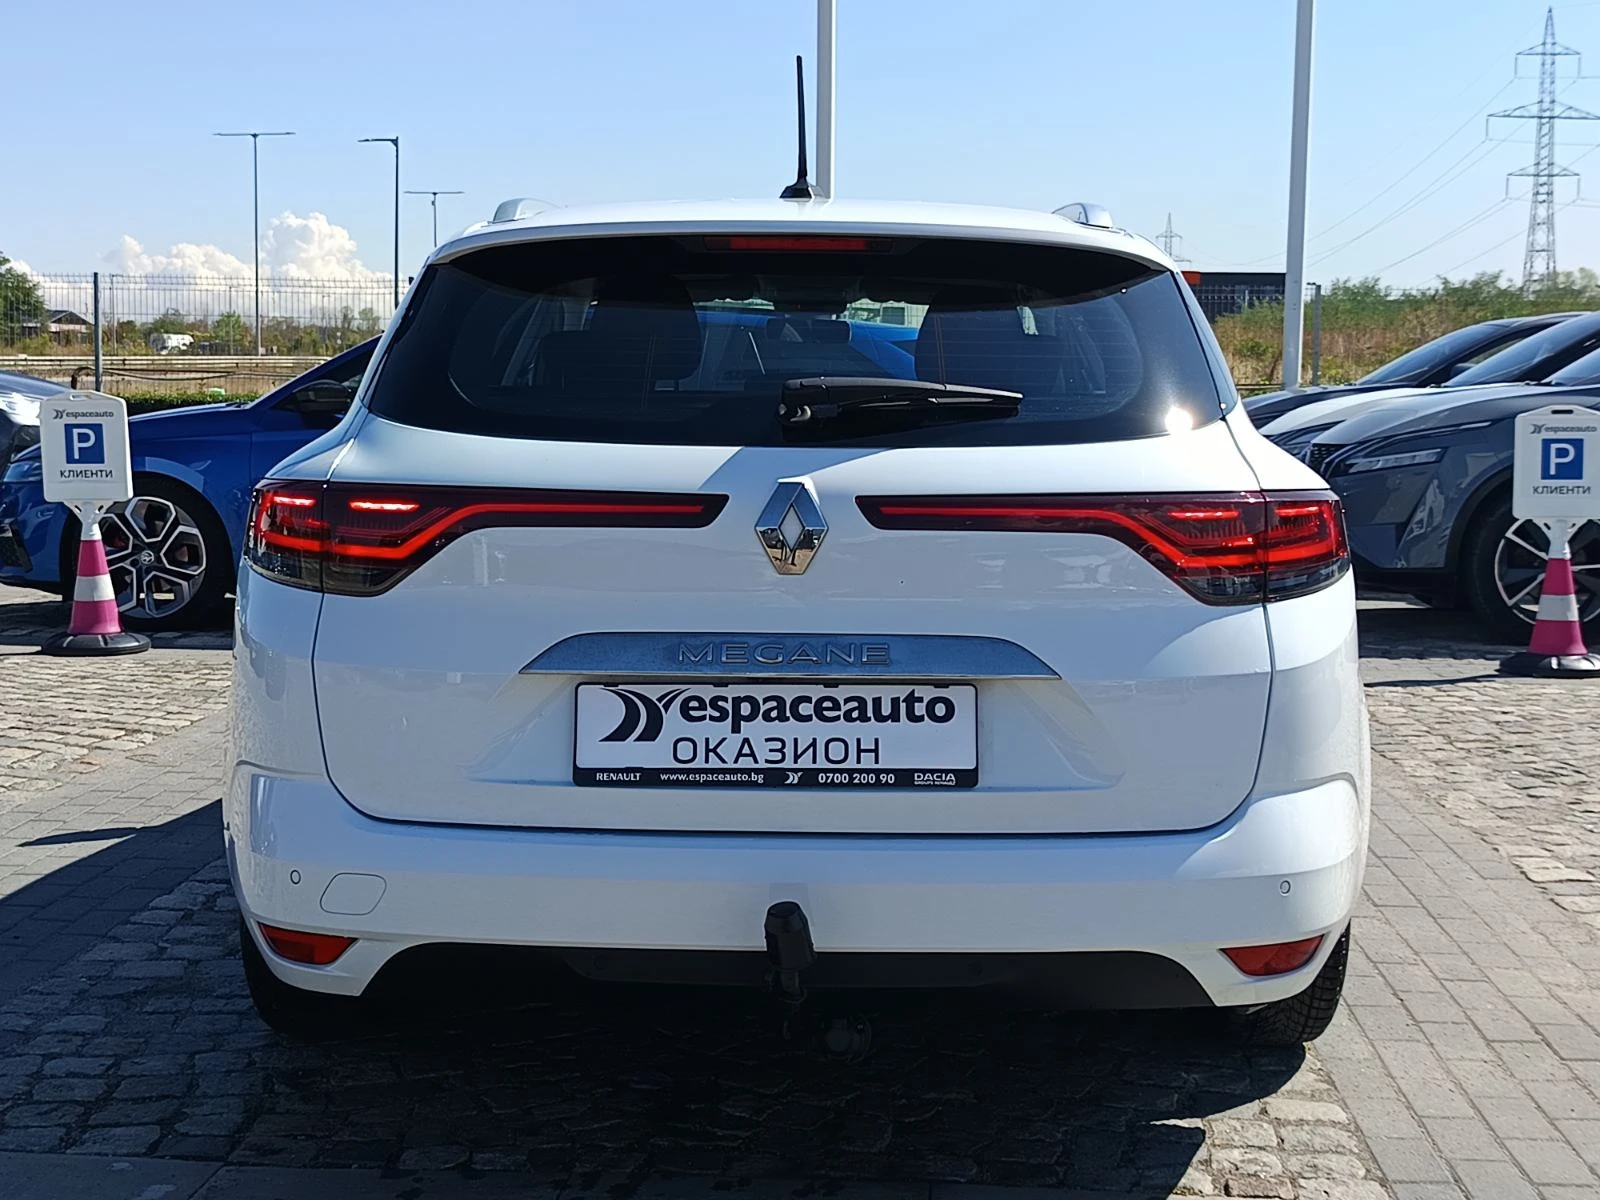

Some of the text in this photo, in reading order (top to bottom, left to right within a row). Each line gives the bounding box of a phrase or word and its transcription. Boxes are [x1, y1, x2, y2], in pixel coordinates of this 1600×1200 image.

[66, 410, 114, 419] espaceauto
[72, 428, 96, 460] P
[1549, 443, 1575, 475] P
[60, 469, 113, 479] КЛИЕНТИ
[1532, 485, 1591, 495] КЛИЕНТИ
[677, 641, 891, 666] MEGANE
[679, 688, 956, 734] espaceauto
[672, 736, 880, 765] ОКАЗИОН
[596, 773, 641, 781] RENAULT
[660, 773, 764, 783] www.espaceauto.bg
[818, 773, 895, 784] 0700 200 90
[914, 773, 956, 783] DACIA
